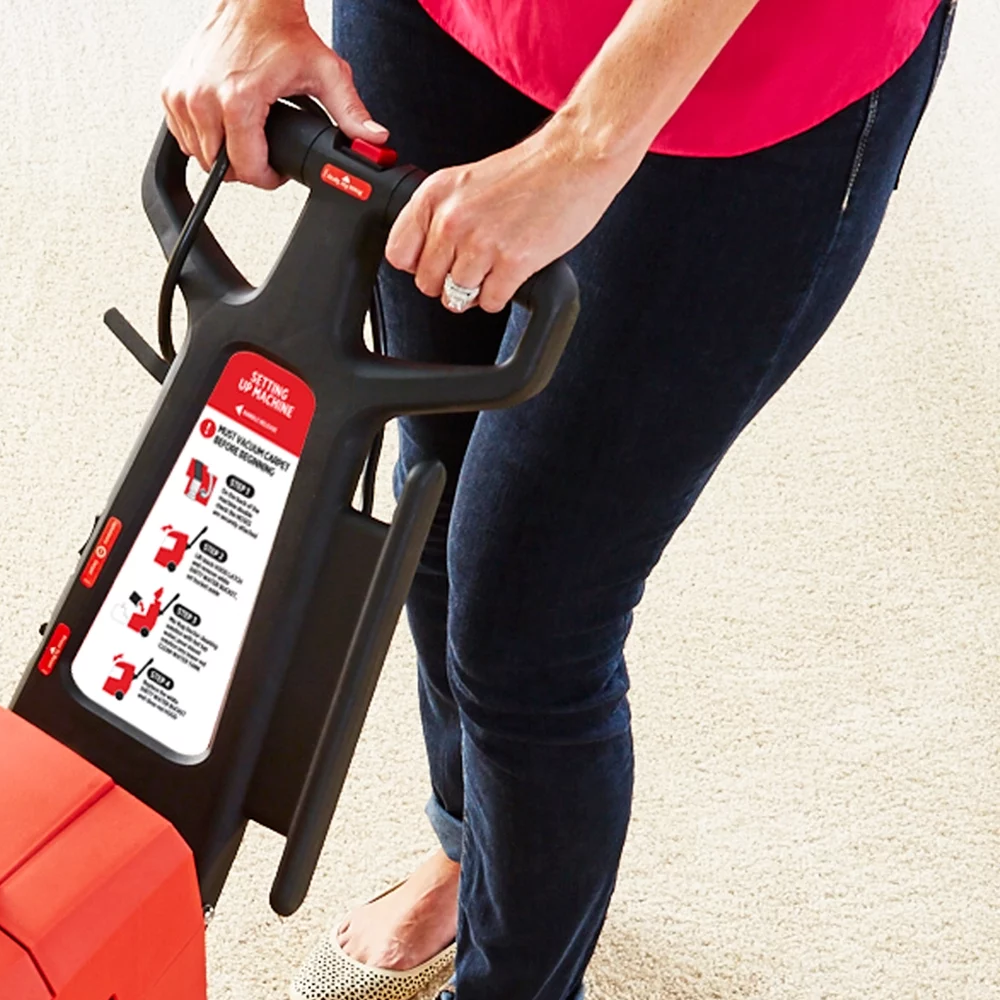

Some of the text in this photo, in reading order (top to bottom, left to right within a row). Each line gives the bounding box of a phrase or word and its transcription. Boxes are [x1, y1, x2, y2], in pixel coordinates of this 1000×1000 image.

[238, 378, 295, 419] UP MACHINE
[250, 371, 289, 400] SETTING
[213, 435, 275, 476] BEFORE BEGINNING
[218, 425, 290, 472] MUST VACUUM CARPET
